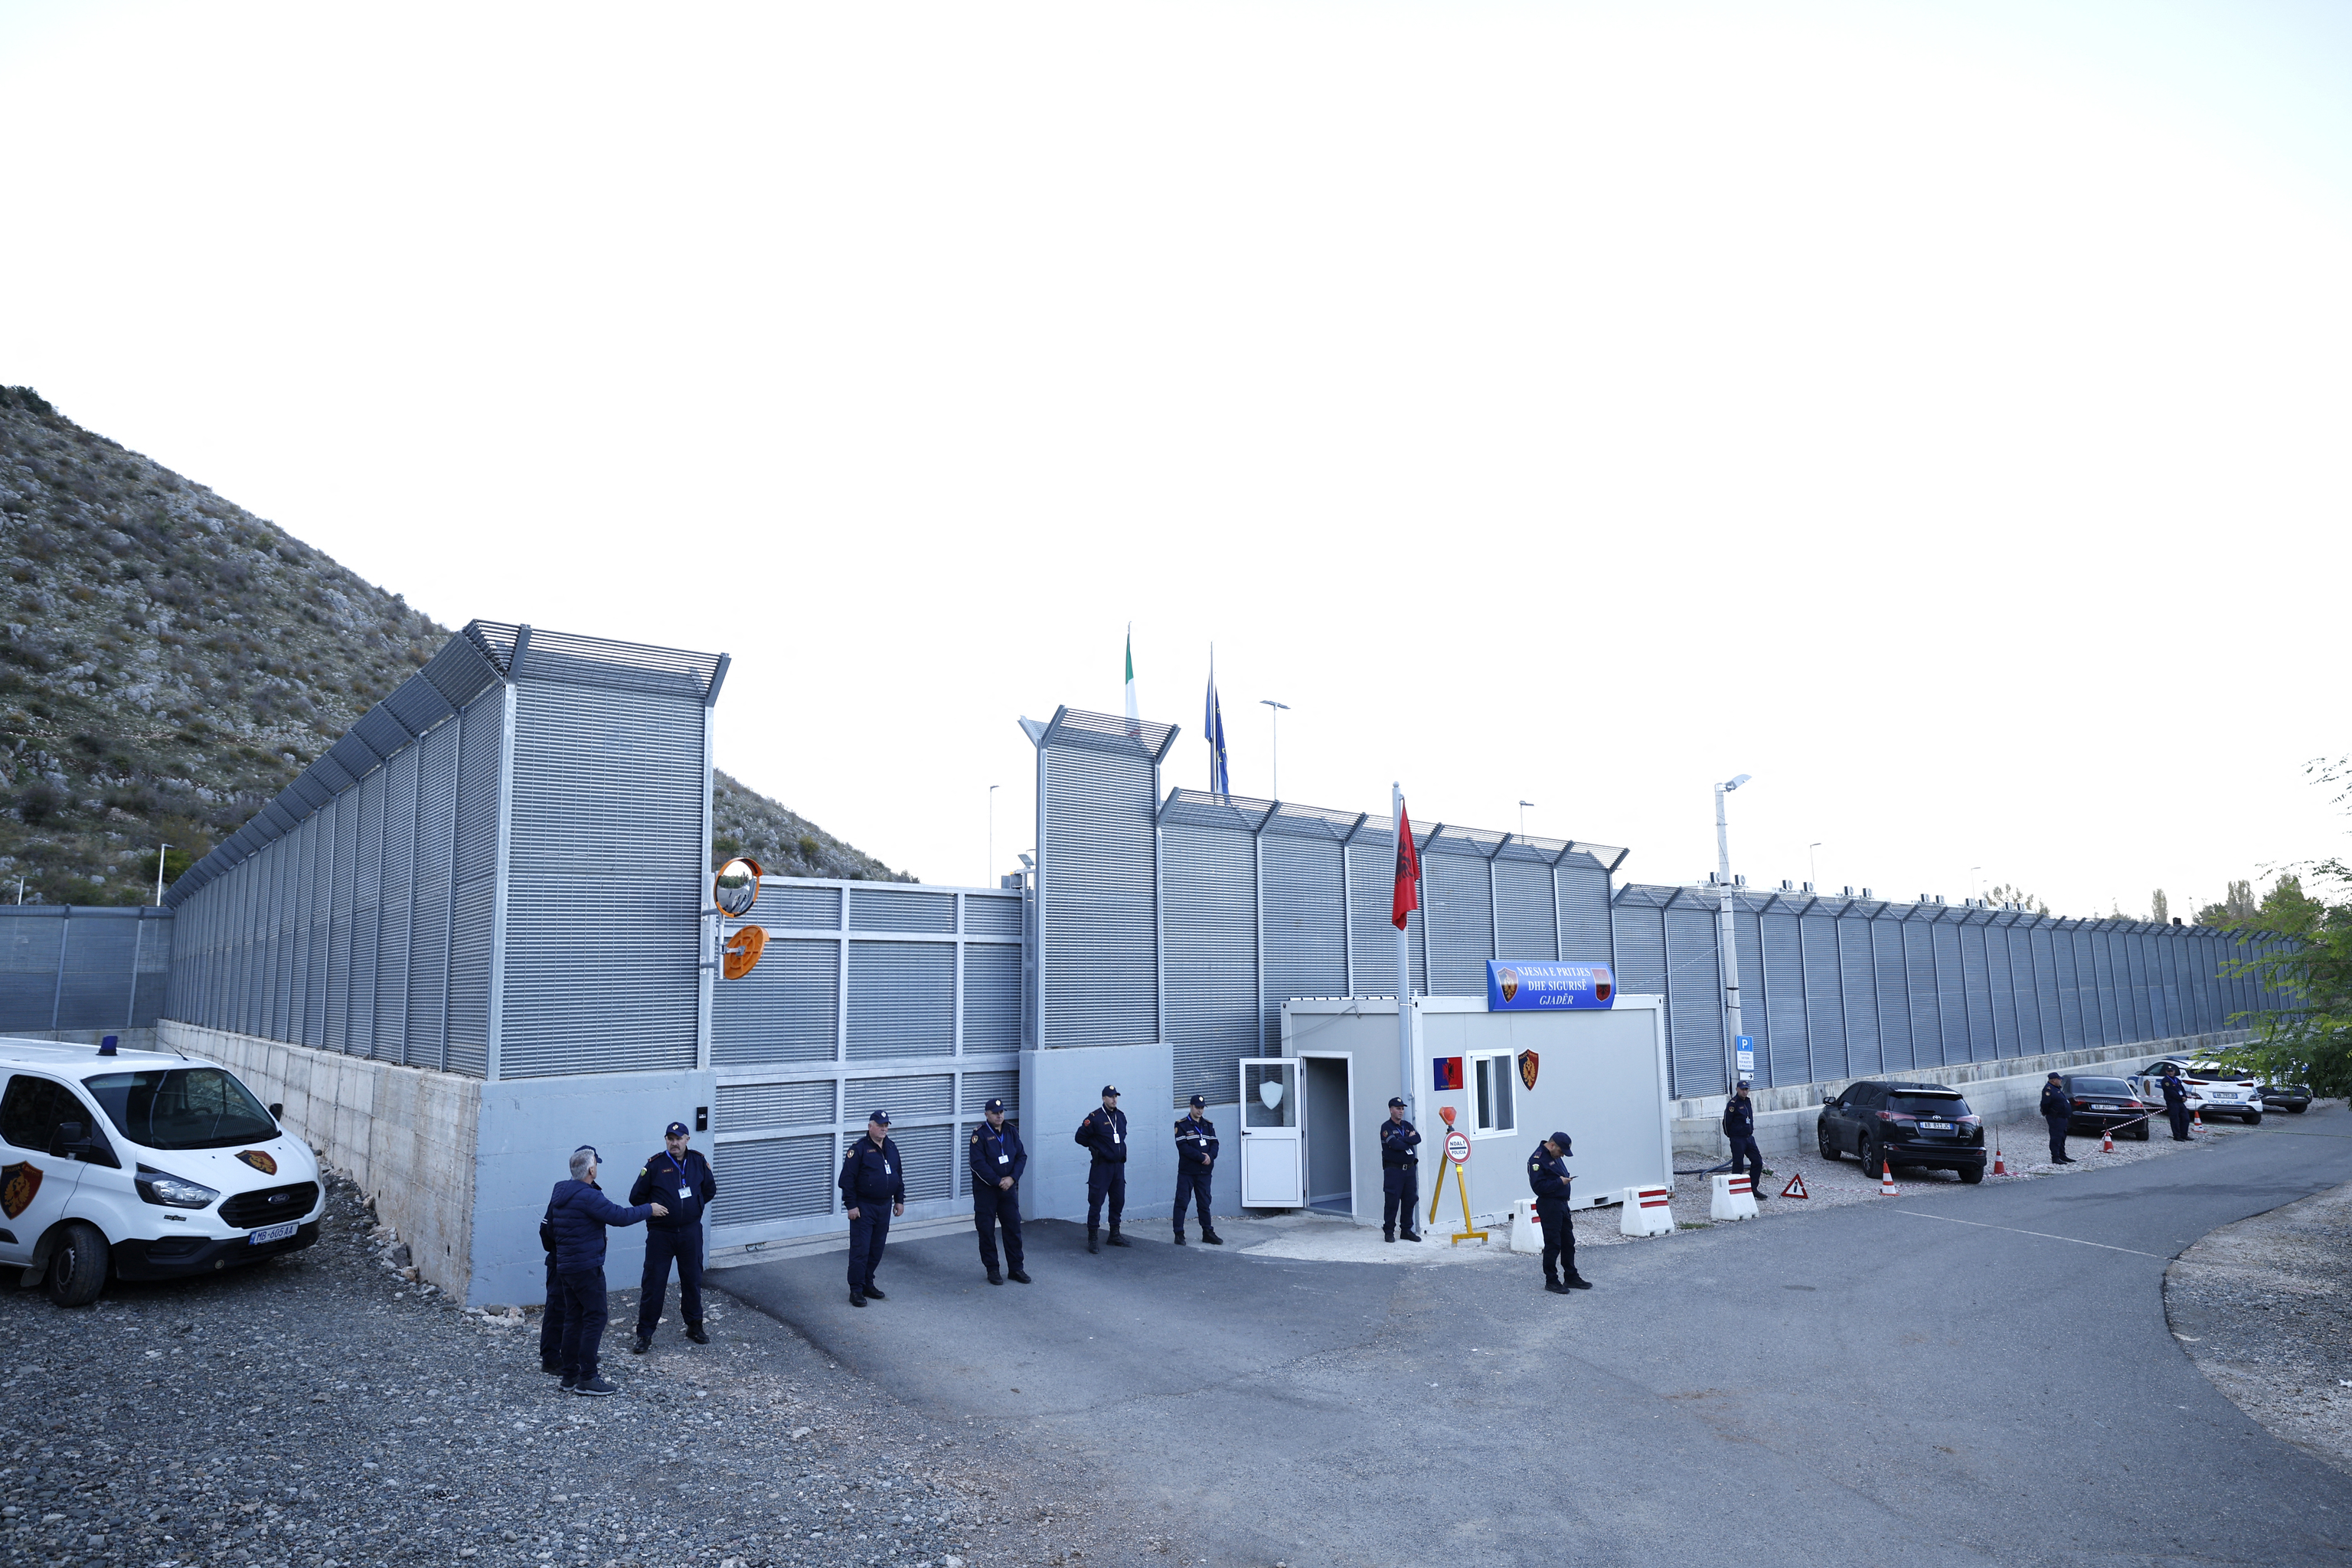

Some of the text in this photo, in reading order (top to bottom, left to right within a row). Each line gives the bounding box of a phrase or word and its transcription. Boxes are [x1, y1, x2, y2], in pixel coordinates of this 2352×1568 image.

[1517, 966, 1548, 976] NJESIA
[1549, 967, 1556, 976] E
[1557, 968, 1591, 977] PRITJES
[1528, 978, 1587, 991] DHE SIGURISË
[1540, 993, 1574, 1005] GJADËR
[1742, 1039, 1748, 1049] P
[256, 1231, 267, 1241] MB
